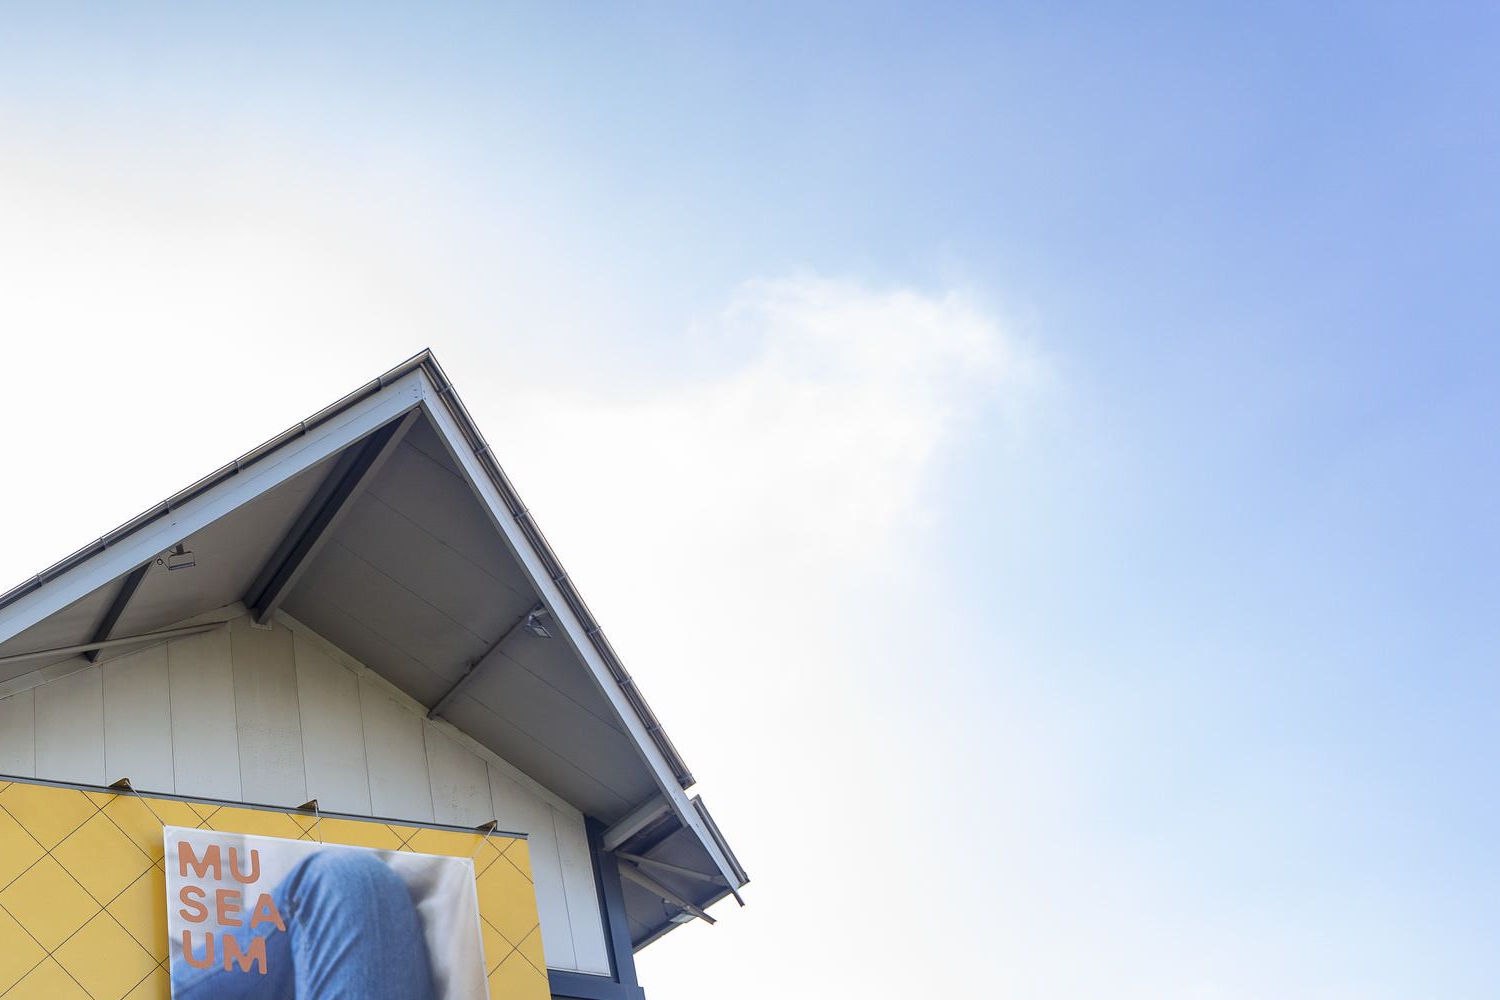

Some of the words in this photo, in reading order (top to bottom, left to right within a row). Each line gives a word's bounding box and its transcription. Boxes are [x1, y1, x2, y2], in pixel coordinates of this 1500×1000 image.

[178, 841, 261, 885] MU
[179, 885, 286, 932] SEA
[182, 929, 268, 975] UM
